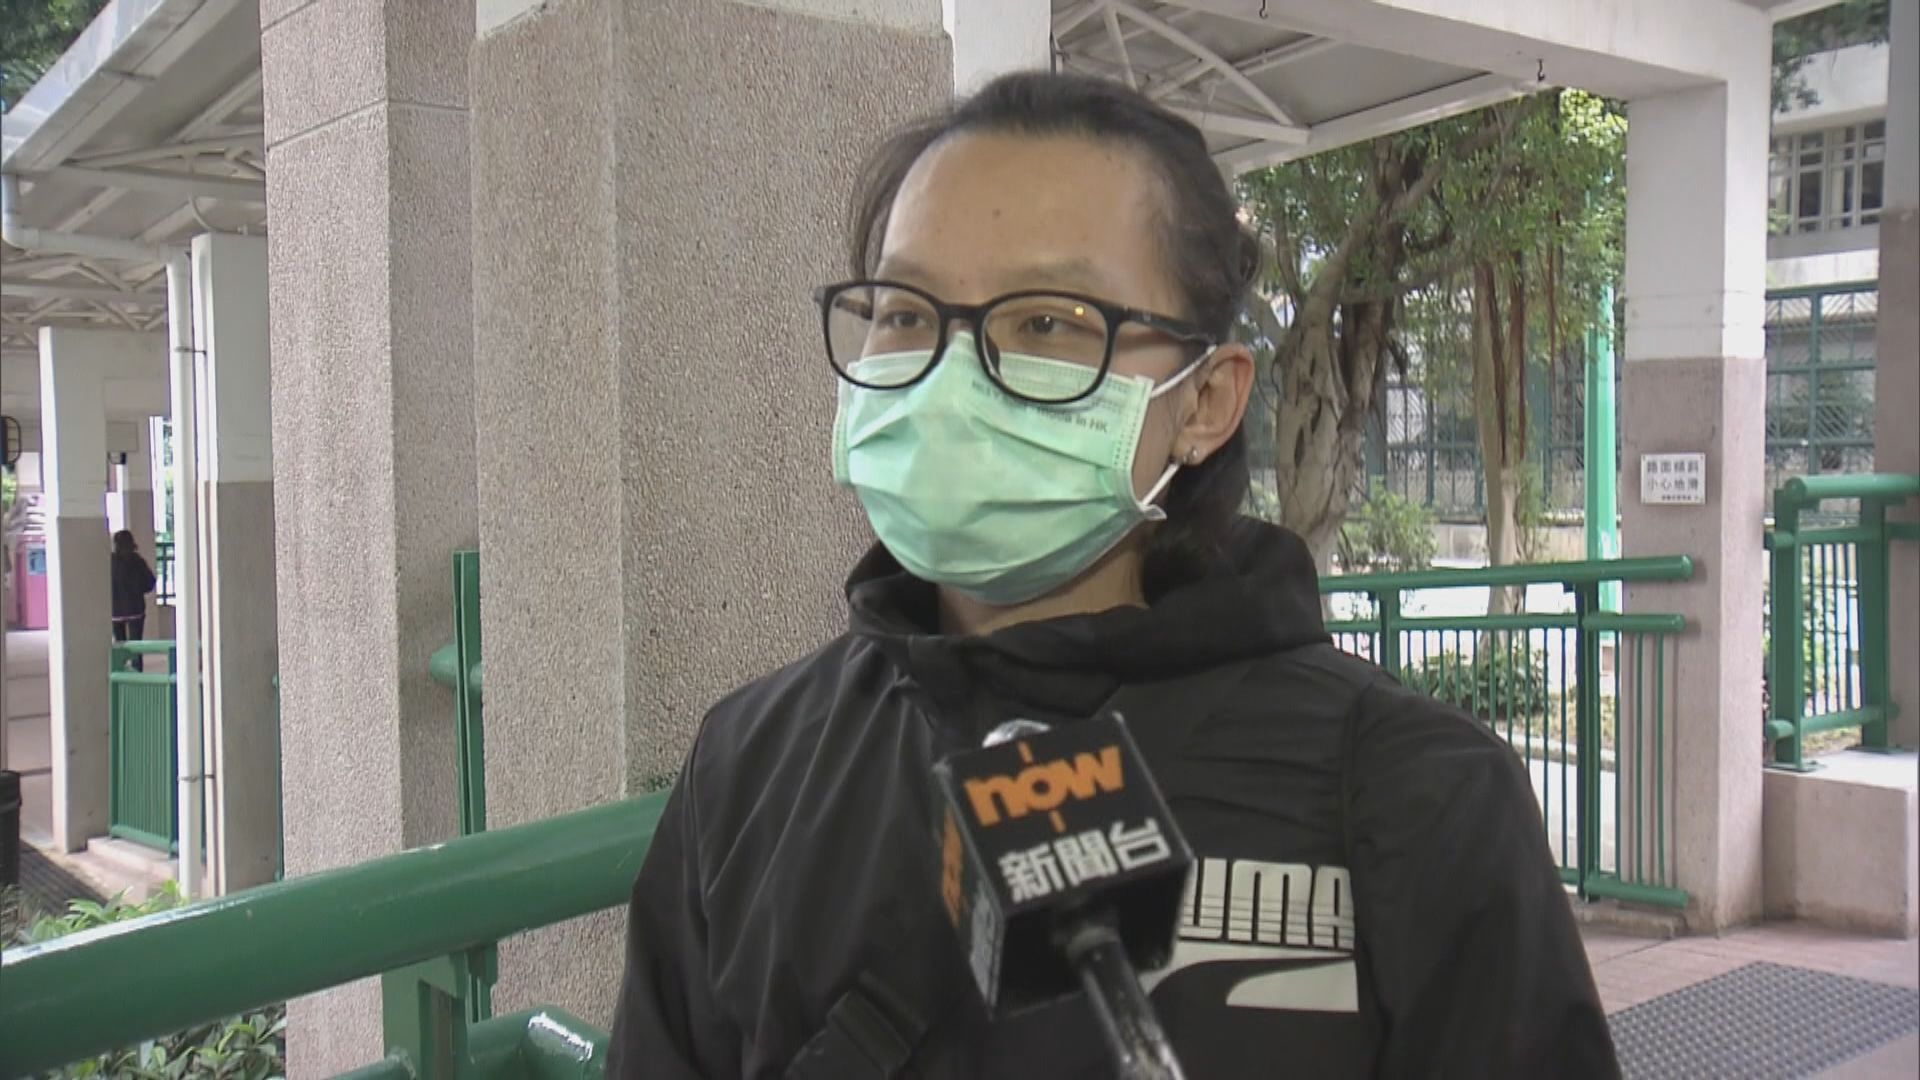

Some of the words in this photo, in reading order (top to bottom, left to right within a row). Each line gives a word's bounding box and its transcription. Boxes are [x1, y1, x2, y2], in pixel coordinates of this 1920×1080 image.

[1090, 418, 1108, 432] HK
[964, 745, 1124, 828] now
[997, 816, 1171, 903] 新聞台
[1177, 857, 1355, 950] UMA
